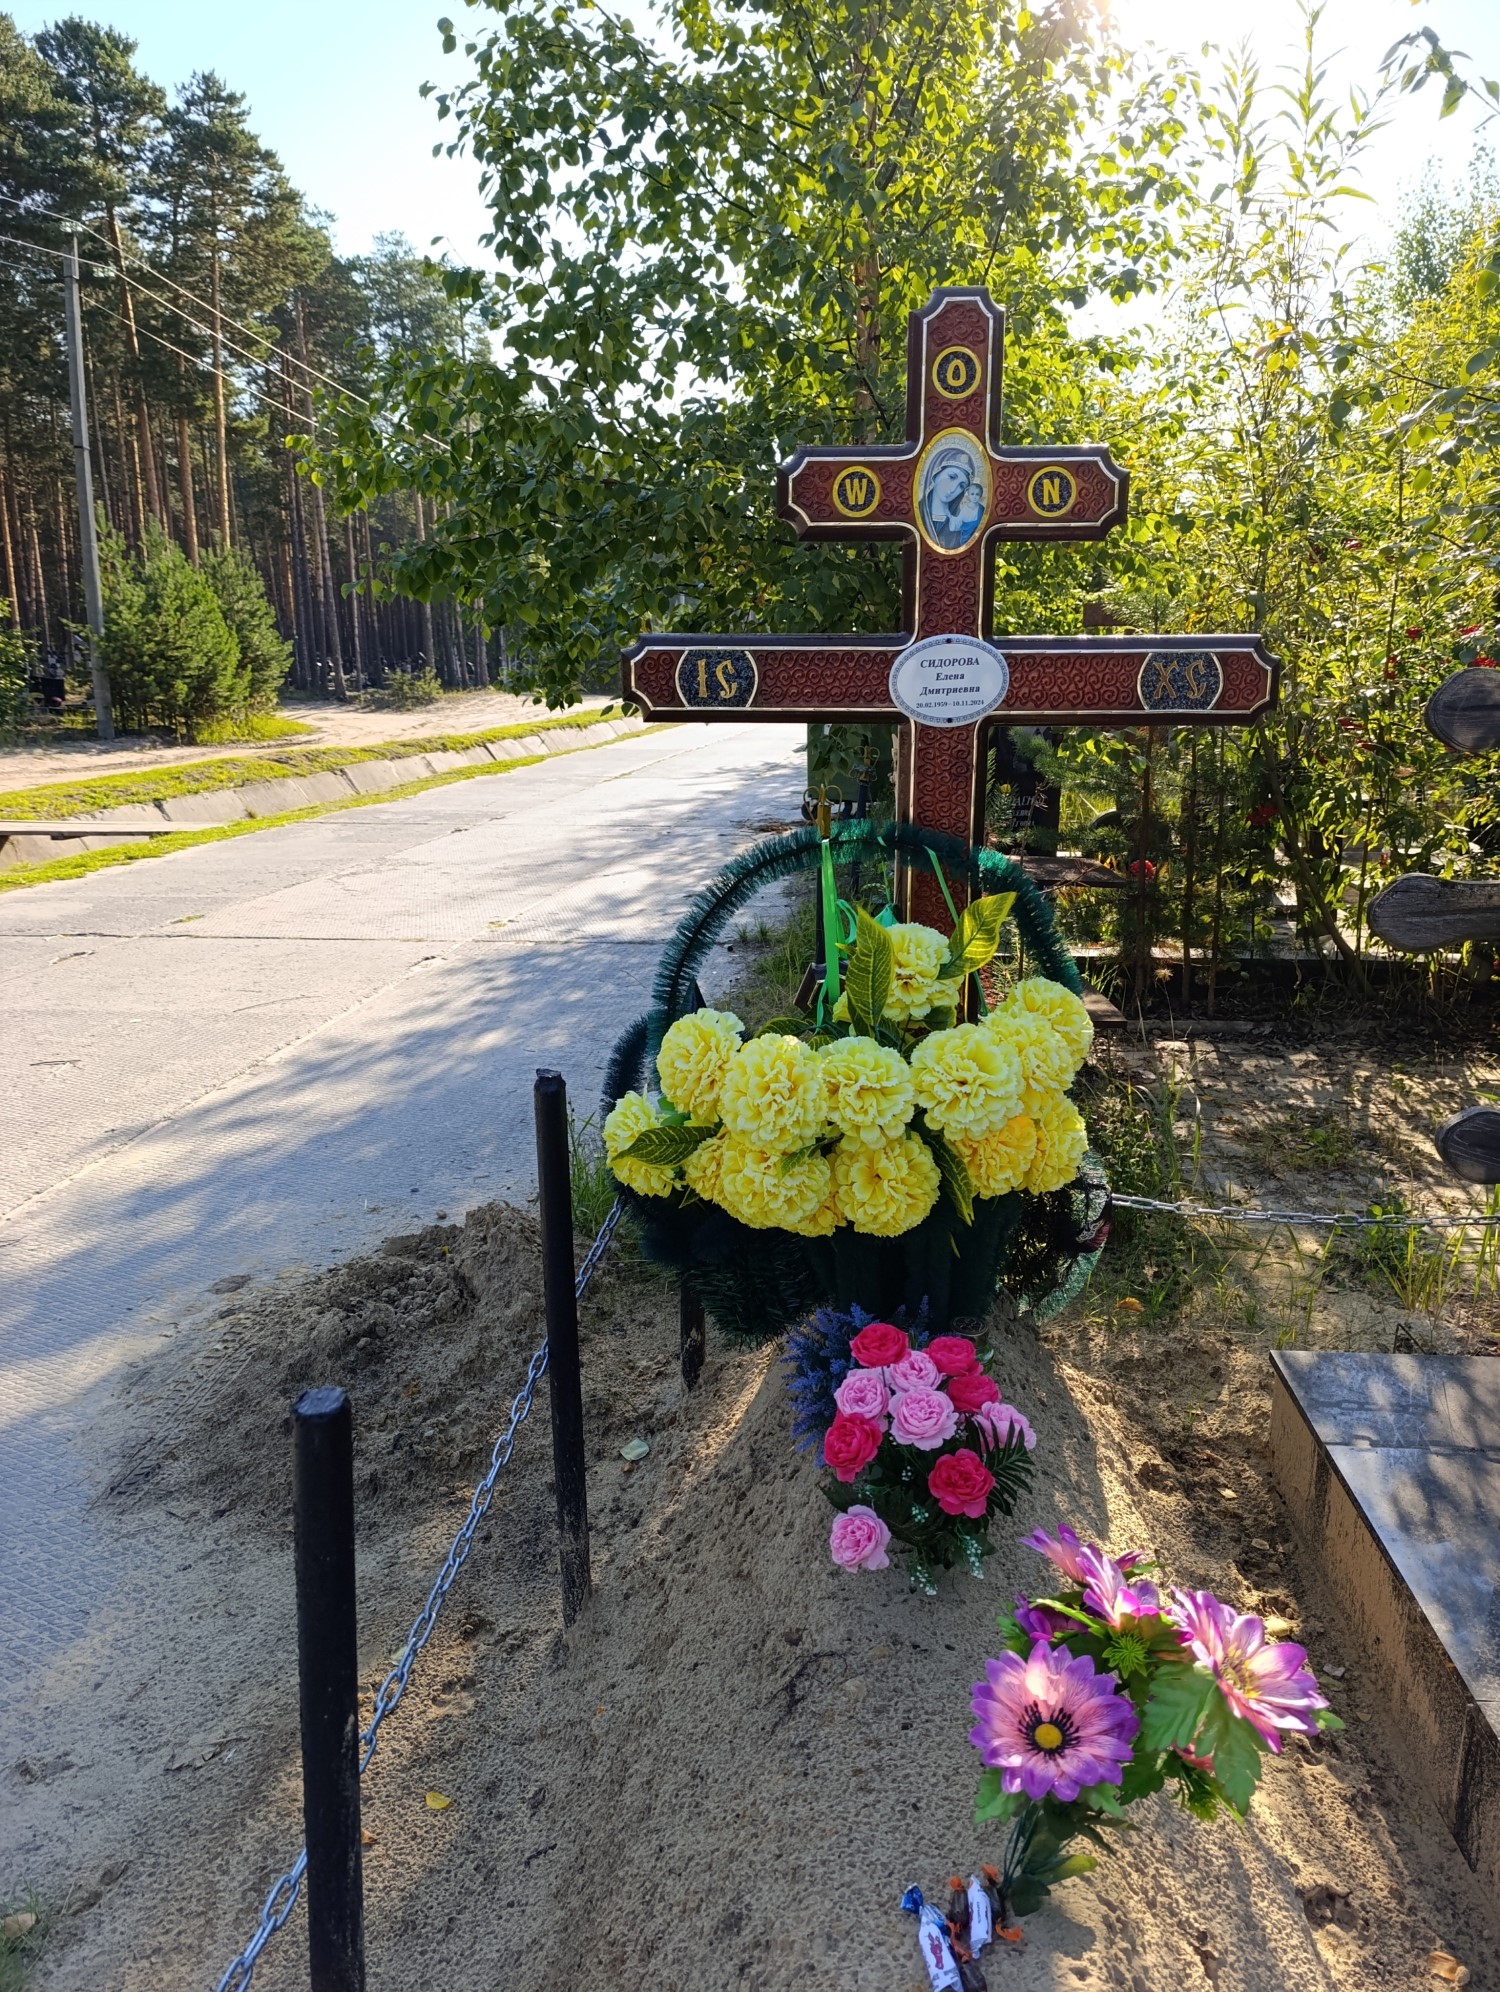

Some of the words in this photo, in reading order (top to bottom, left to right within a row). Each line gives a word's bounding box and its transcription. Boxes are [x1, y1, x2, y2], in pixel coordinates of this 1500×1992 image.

[920, 657, 980, 669] СИДОРОВА
[935, 672, 965, 681] Елена
[919, 685, 980, 697] Дмитриевна
